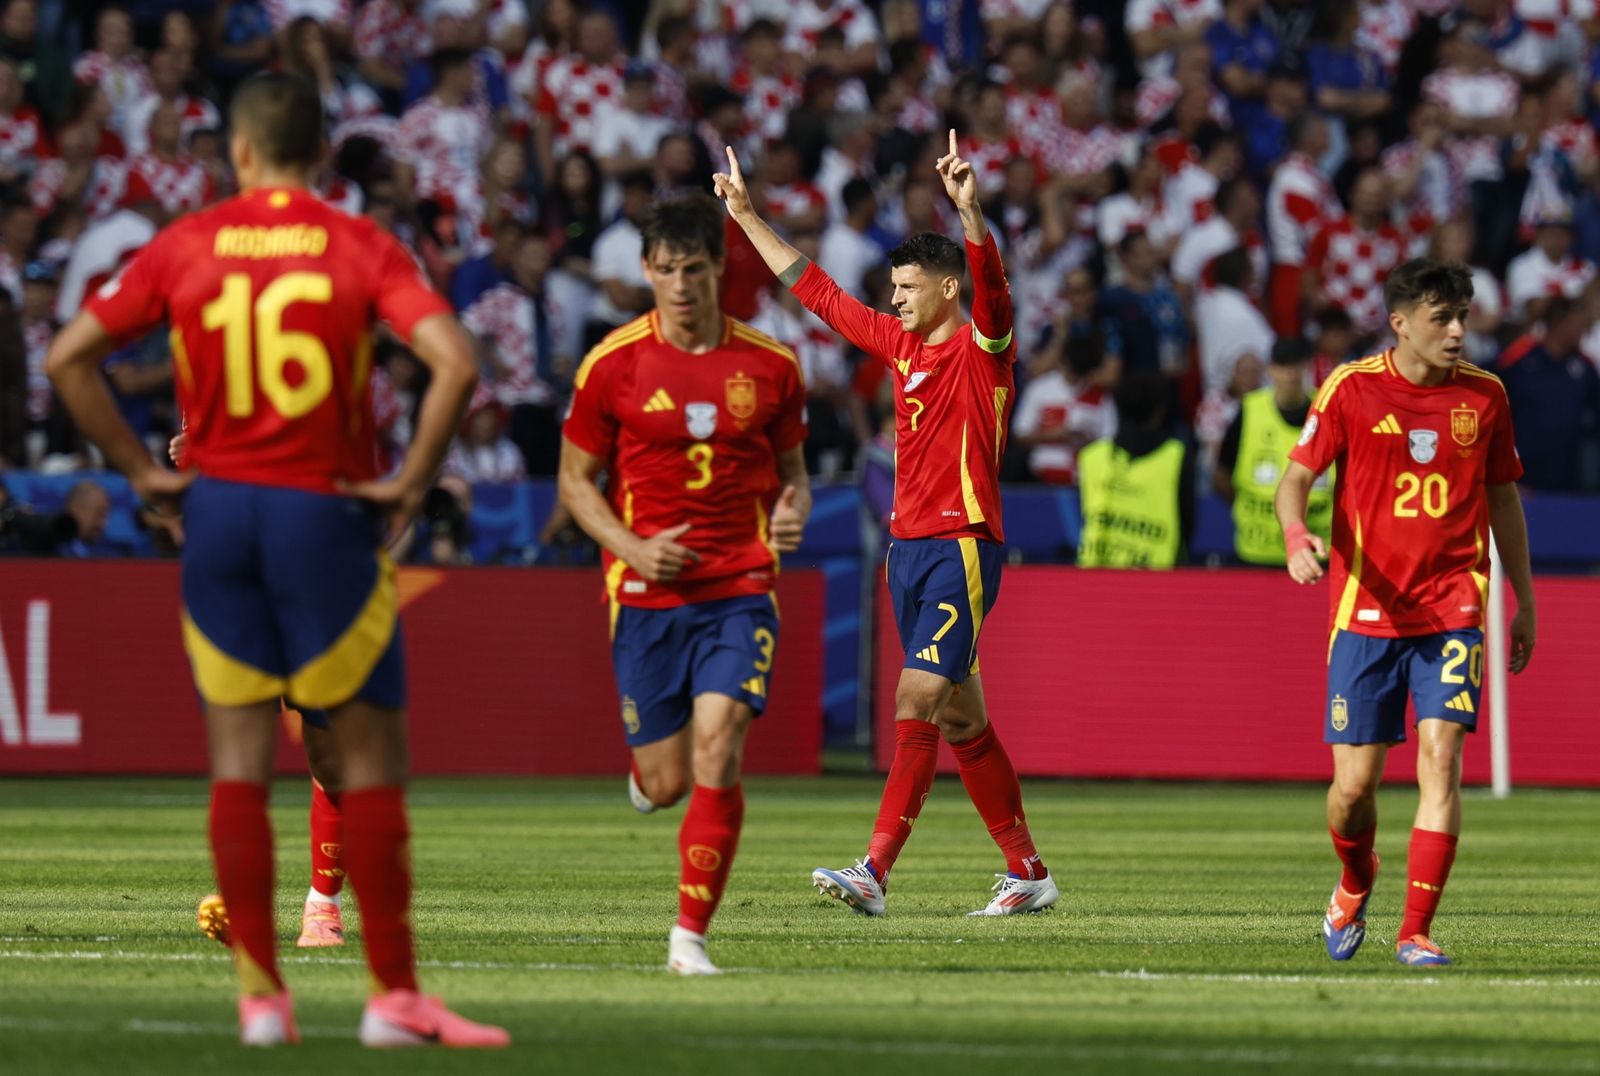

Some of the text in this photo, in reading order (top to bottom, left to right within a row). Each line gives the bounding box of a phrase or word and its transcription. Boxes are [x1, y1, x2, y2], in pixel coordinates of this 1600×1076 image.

[203, 274, 333, 418] 16
[905, 397, 924, 431] 7
[686, 443, 713, 489] 3
[1394, 471, 1449, 518] 20
[932, 602, 959, 642] 7
[754, 627, 775, 673] 3
[1440, 639, 1484, 688] 20
